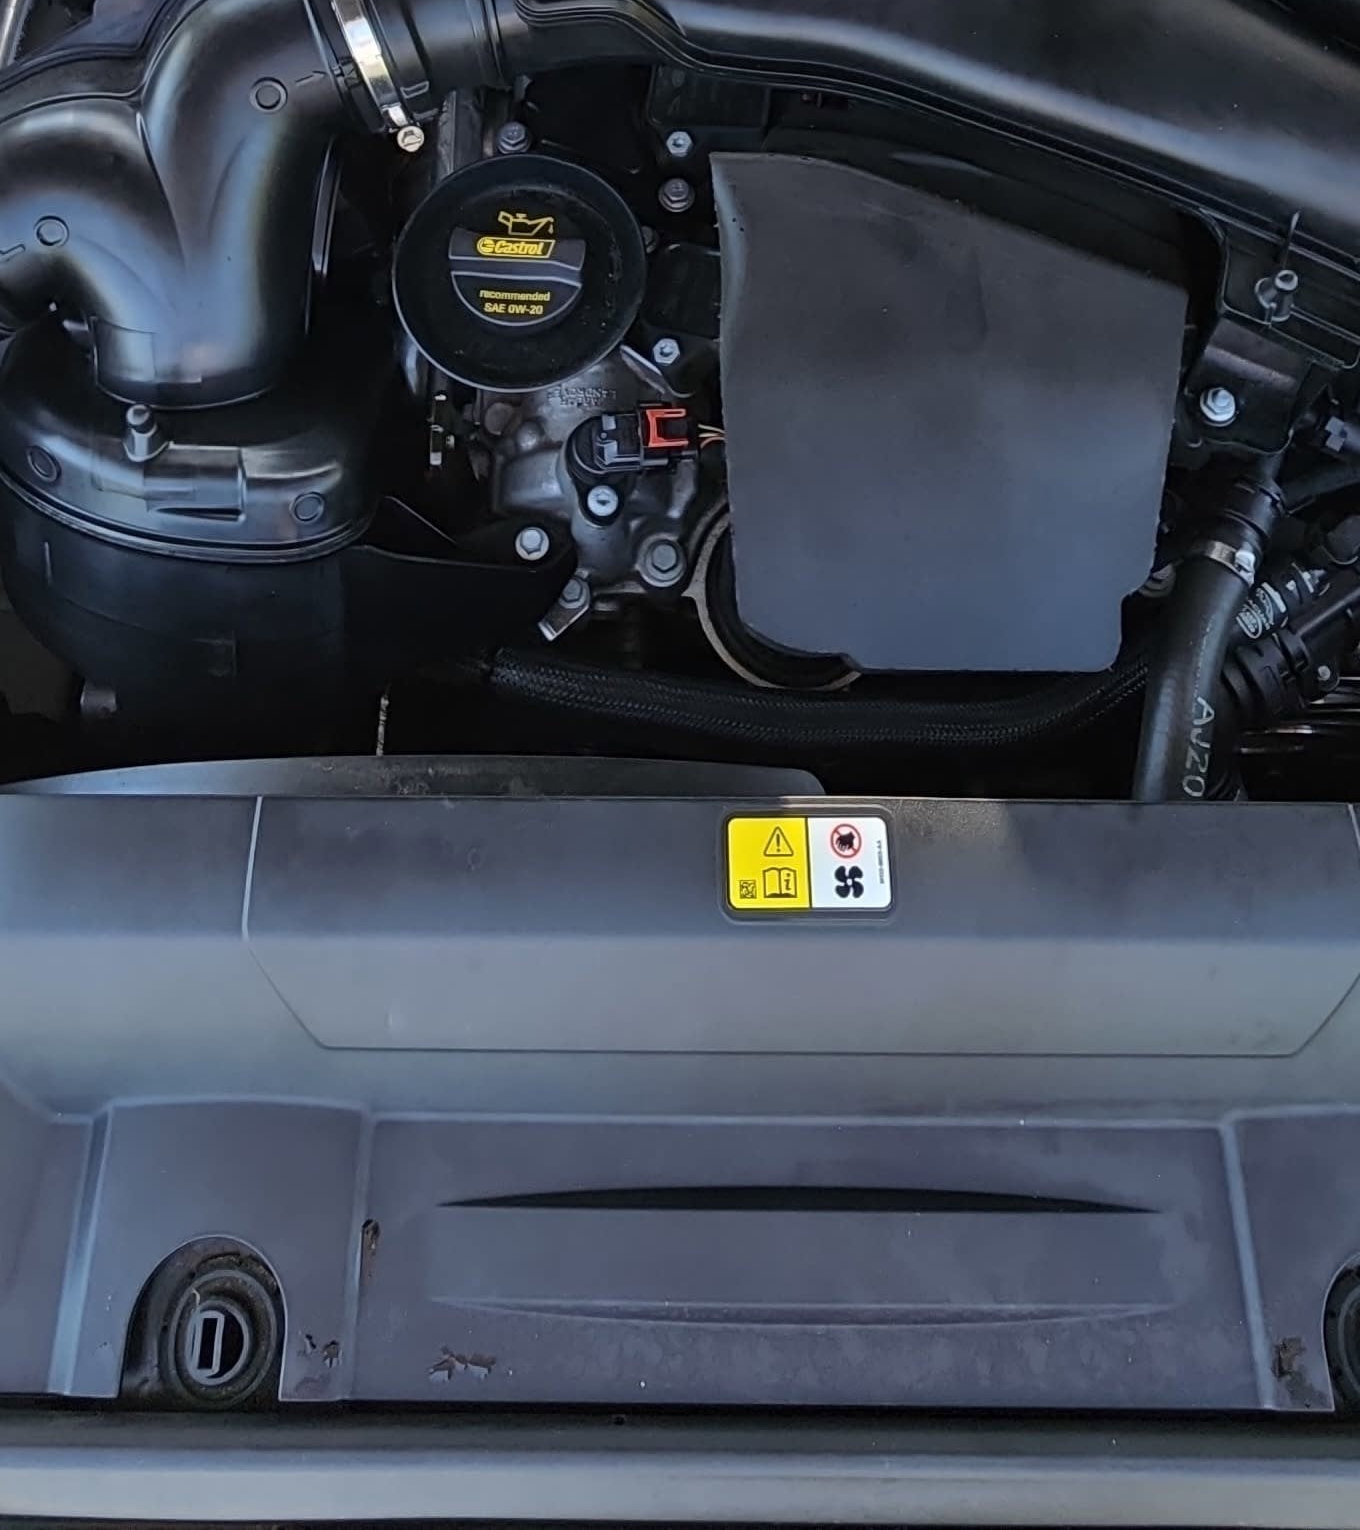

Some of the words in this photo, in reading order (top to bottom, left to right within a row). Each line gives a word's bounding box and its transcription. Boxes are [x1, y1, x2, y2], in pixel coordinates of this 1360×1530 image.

[494, 239, 544, 256] Castrol
[479, 288, 551, 302] recommended
[484, 302, 506, 314] SAE
[507, 303, 544, 316] 0W-20
